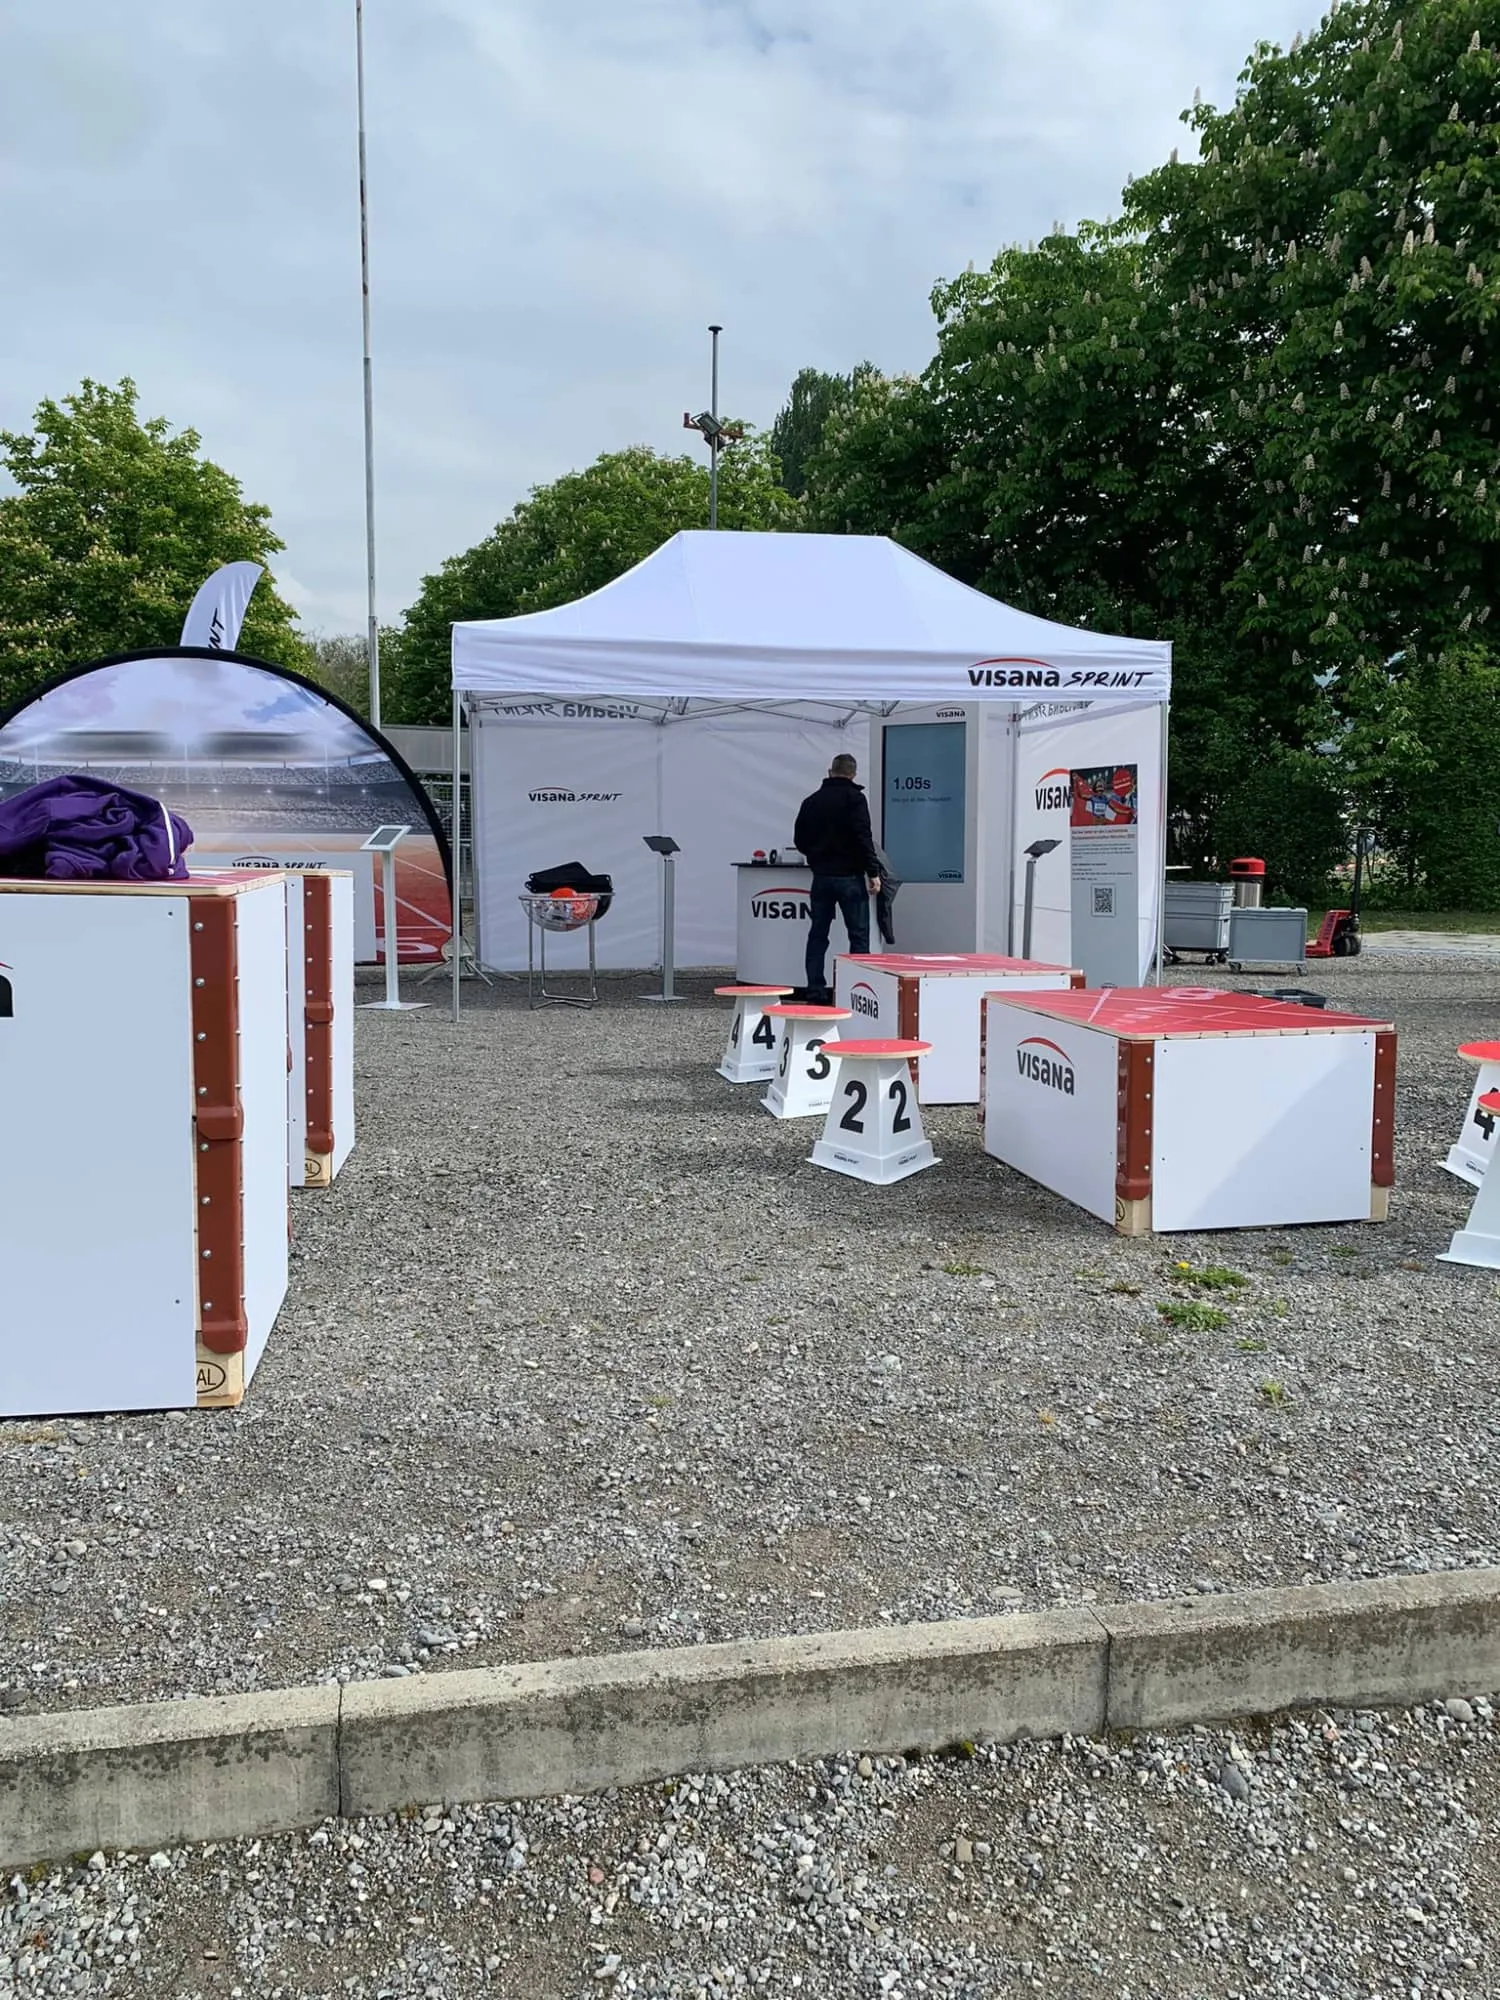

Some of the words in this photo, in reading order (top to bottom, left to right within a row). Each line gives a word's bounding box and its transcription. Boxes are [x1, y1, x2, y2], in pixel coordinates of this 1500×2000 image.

[208, 607, 225, 649] NT
[1063, 671, 1154, 688] SPRINT
[577, 793, 624, 802] SPRINT
[893, 776, 931, 790] 1.05s
[1035, 785, 1072, 811] VISaN
[752, 900, 812, 920] VISaN
[732, 1013, 741, 1049] 4
[752, 1014, 776, 1050] 4
[780, 1036, 790, 1078] 3
[806, 1038, 831, 1080] 3
[839, 1079, 867, 1134] 2
[889, 1079, 911, 1134] 2
[196, 1367, 217, 1386] AL
